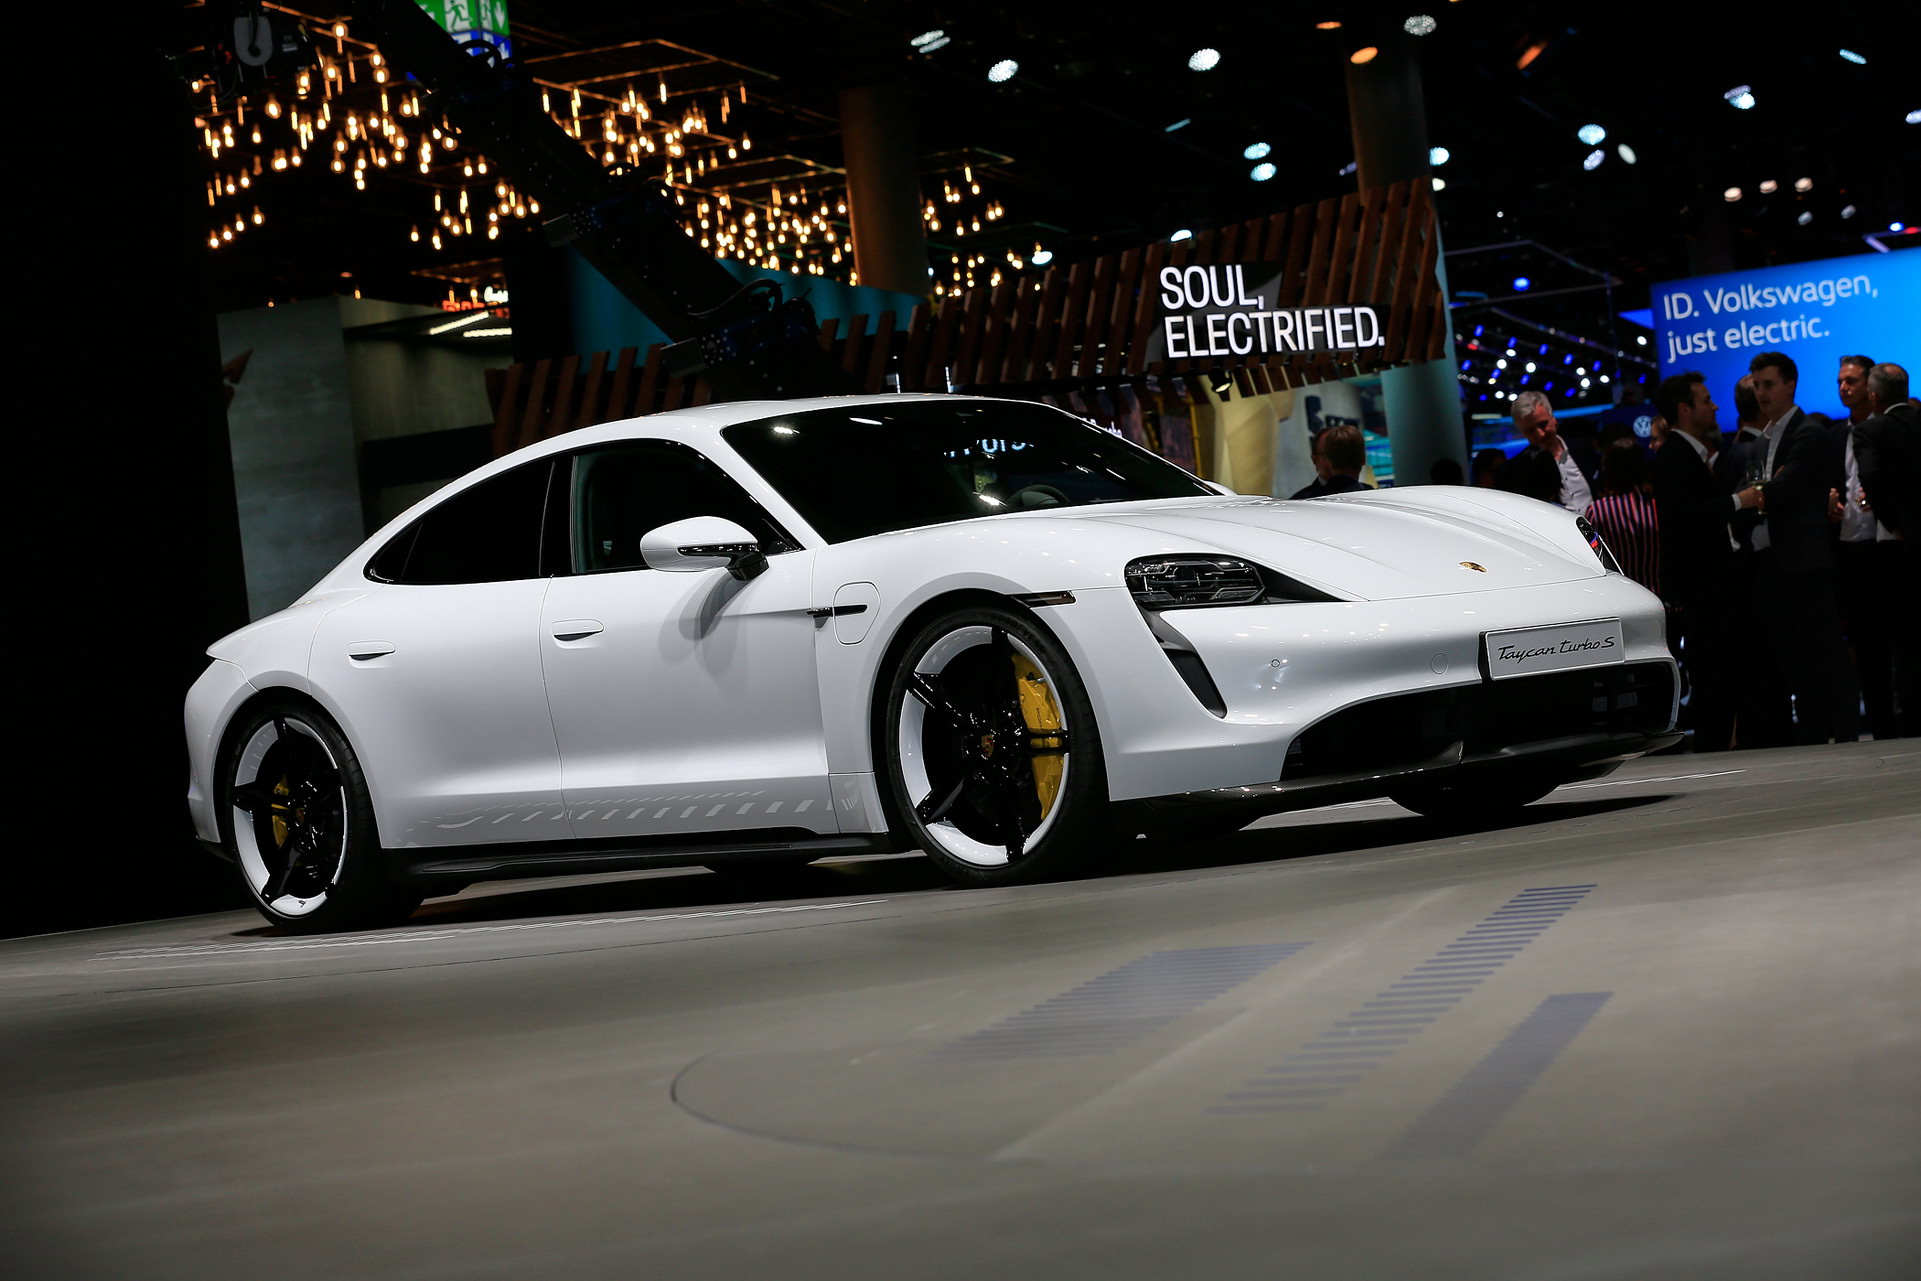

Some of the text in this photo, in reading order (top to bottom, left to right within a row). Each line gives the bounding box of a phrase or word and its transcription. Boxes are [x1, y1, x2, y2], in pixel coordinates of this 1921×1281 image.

[1160, 264, 1264, 310] SOUL,
[1663, 275, 1878, 320] ID. Volkswagen,
[1164, 306, 1385, 358] ELECTRIFIED.
[1667, 314, 1830, 363] just electric.
[1498, 636, 1615, 663] Taycan turbo S
